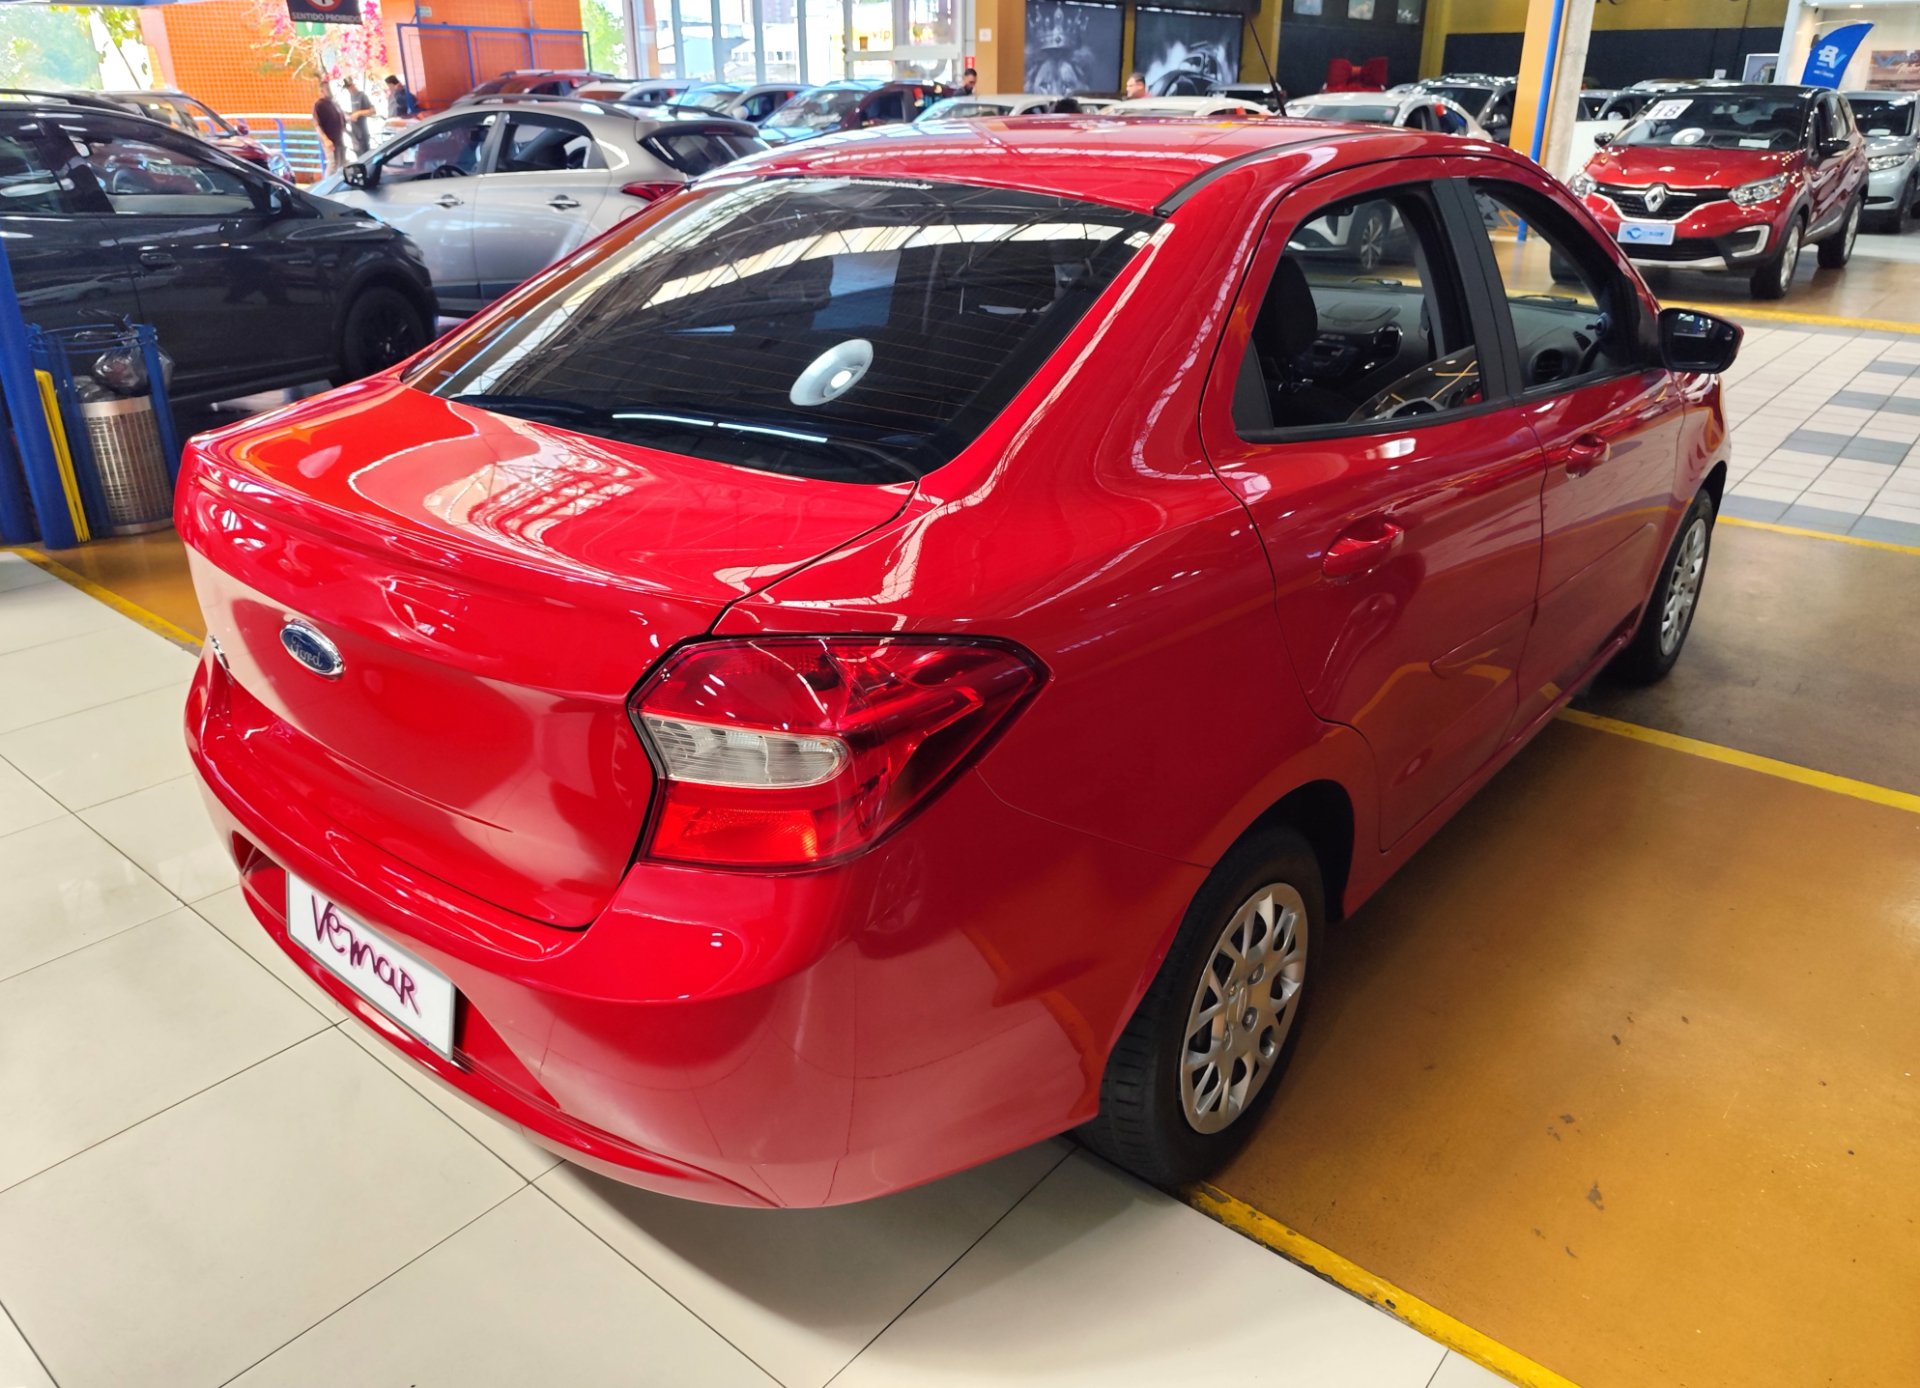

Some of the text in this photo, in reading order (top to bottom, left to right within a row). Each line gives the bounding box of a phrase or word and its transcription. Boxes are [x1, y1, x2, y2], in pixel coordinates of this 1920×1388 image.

[292, 12, 361, 23] SENTIDO PROIBIDO
[289, 633, 324, 668] Ford
